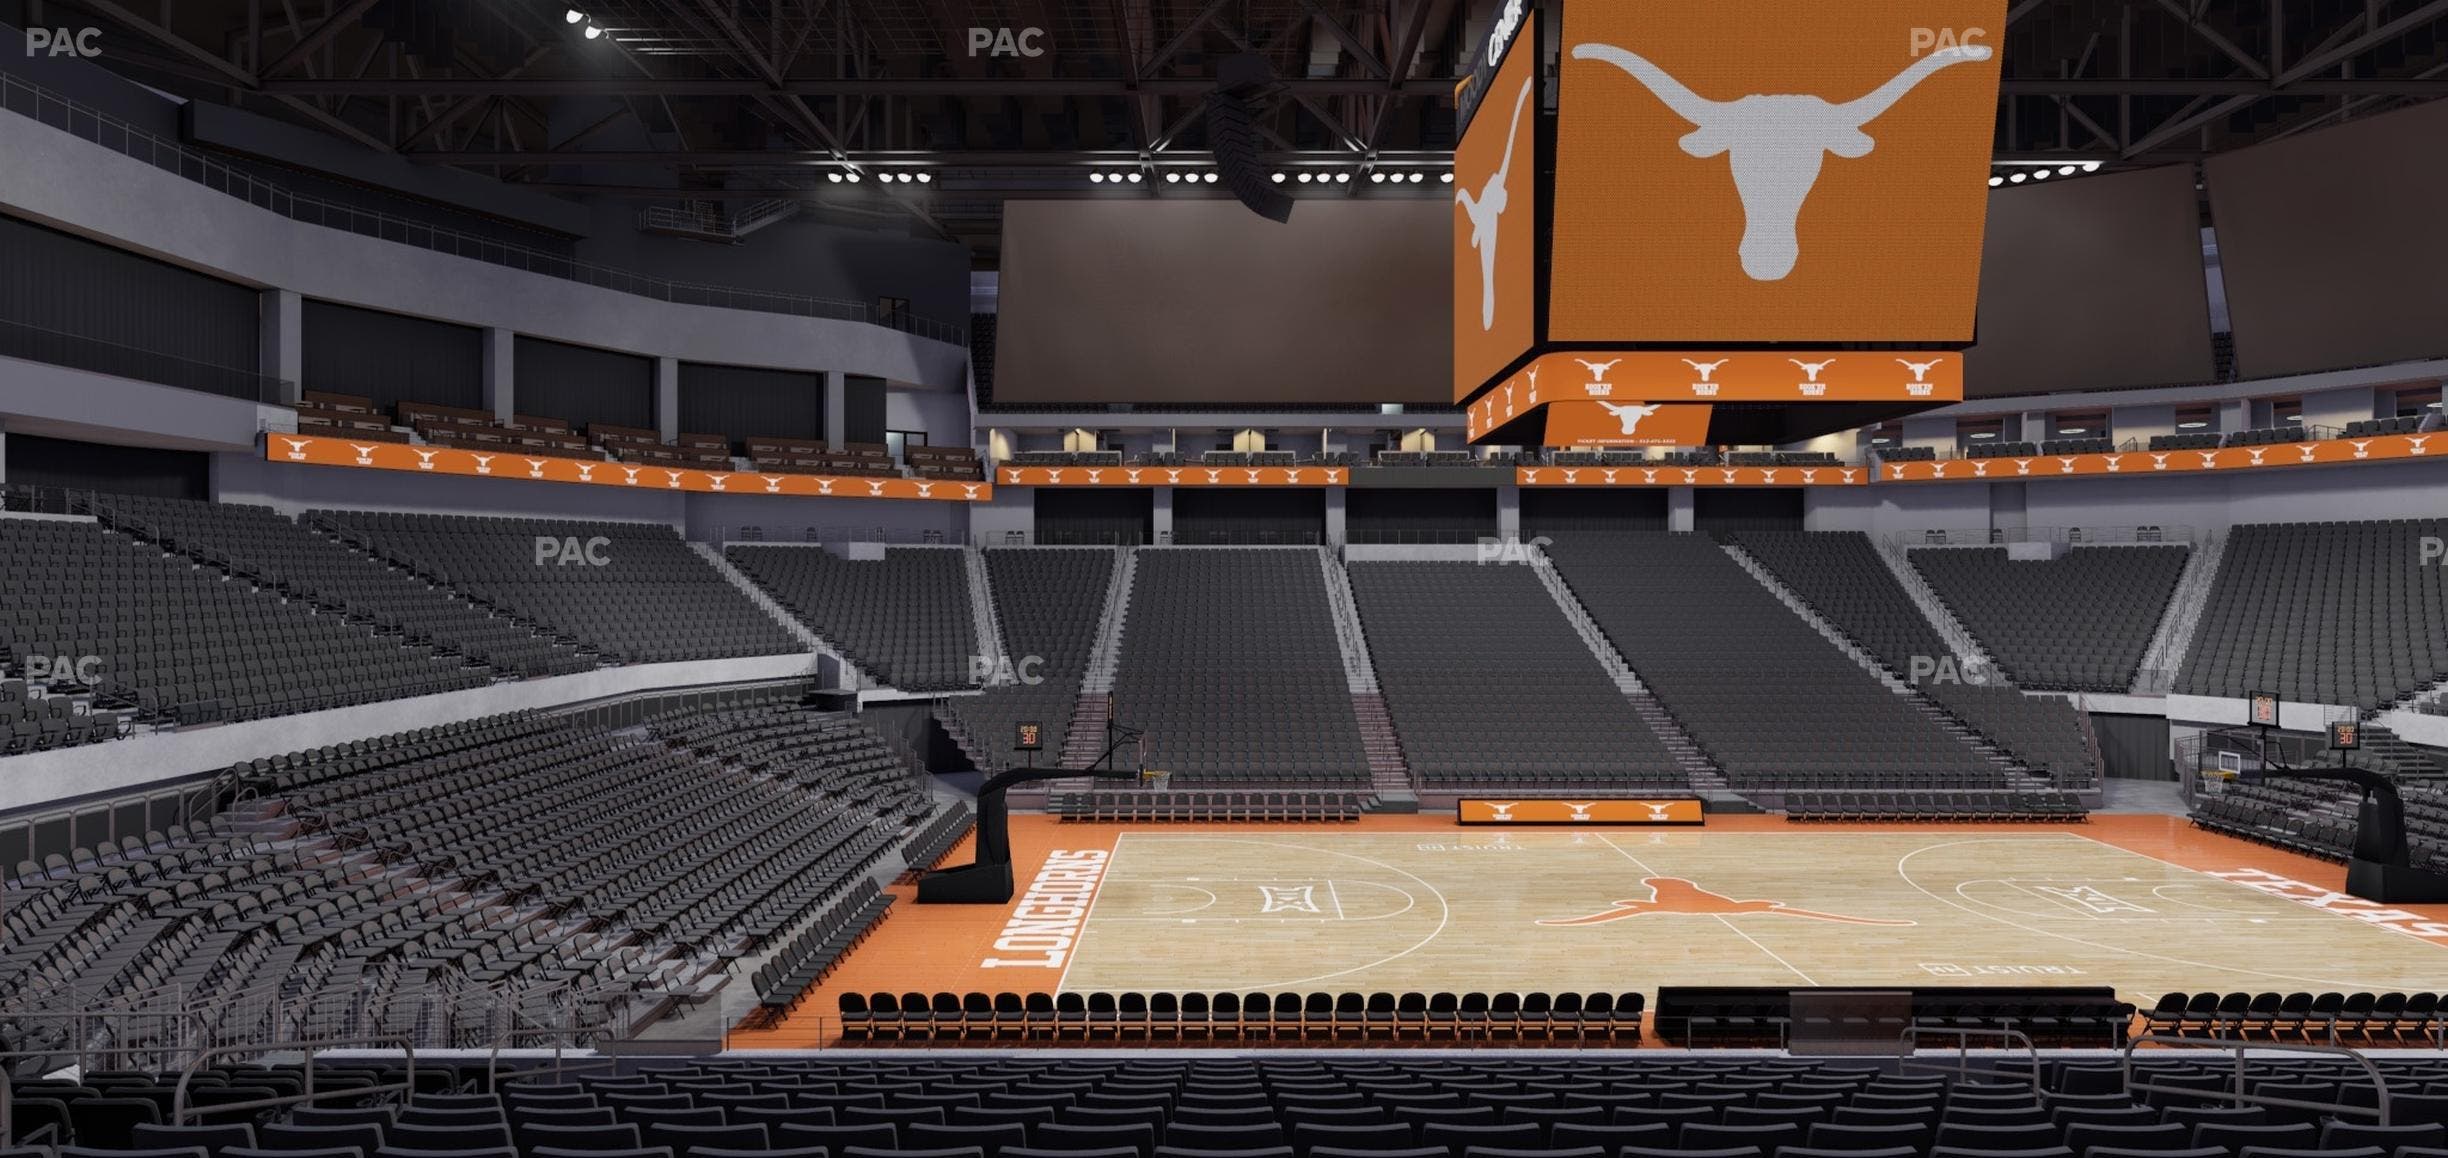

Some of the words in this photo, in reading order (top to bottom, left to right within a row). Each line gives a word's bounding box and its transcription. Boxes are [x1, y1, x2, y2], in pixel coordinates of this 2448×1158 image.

[1022, 732, 1036, 745] 30
[2340, 732, 2353, 745] 30
[980, 849, 1109, 968] LONGHORNS
[2203, 867, 2448, 937] TEXAS
